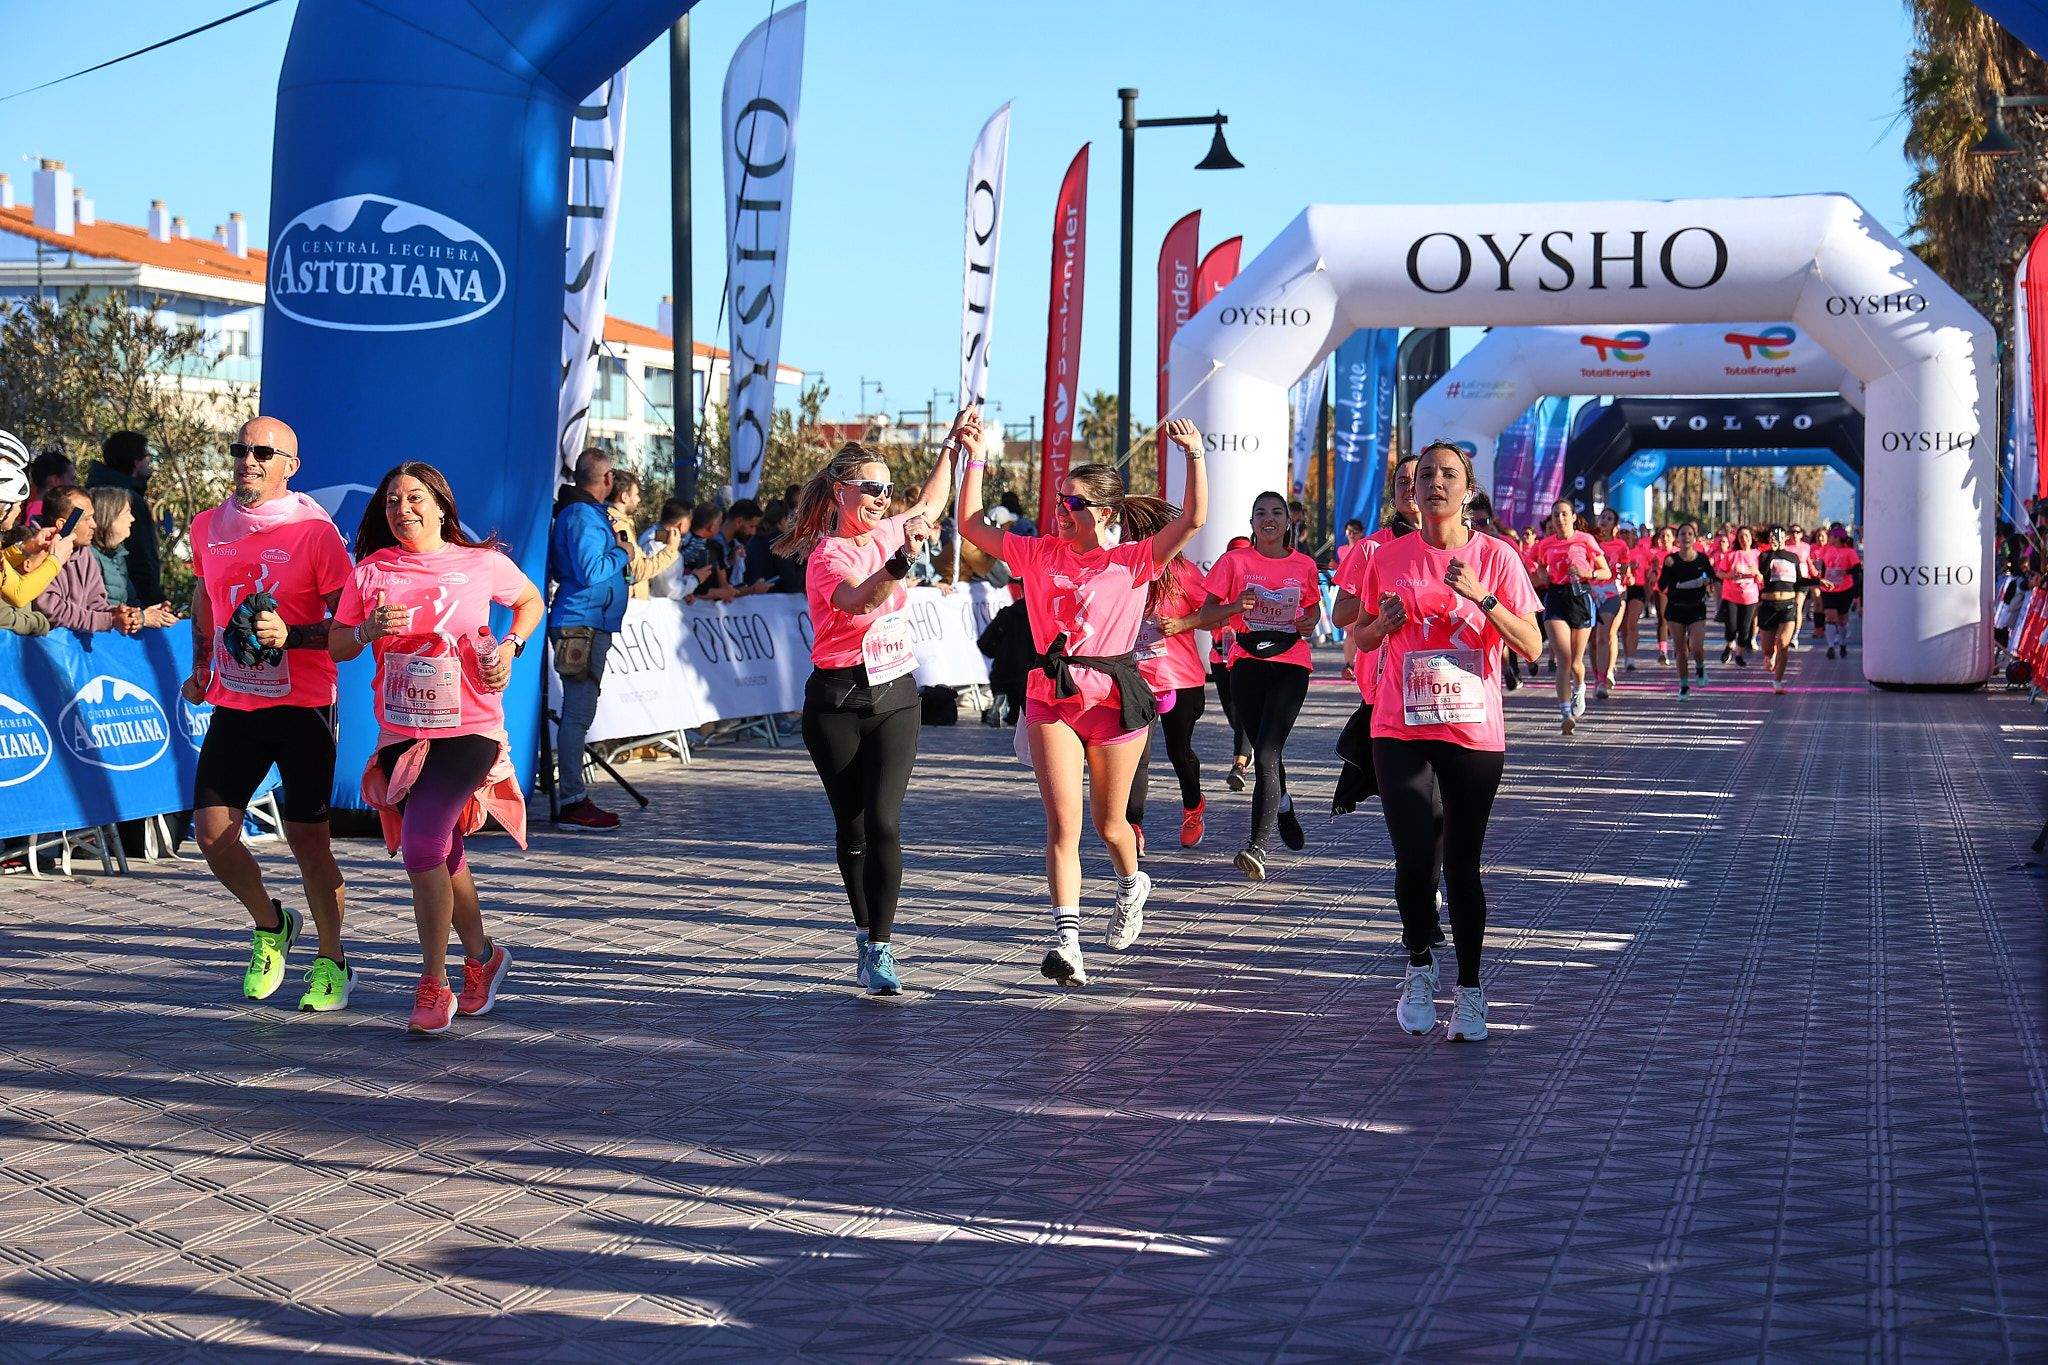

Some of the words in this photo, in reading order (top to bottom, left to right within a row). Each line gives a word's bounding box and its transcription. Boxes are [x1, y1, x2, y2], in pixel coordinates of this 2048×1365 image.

[302, 241, 379, 254] CENTRAL
[389, 243, 480, 262] LECHERA
[1406, 227, 1729, 294] OYSHO
[276, 244, 487, 303] ASTURIANA
[735, 97, 789, 484] OYSHO
[1826, 293, 1926, 316] OYSHO
[1220, 307, 1311, 327] OYSHO
[1580, 367, 1651, 379] TotalEnergies
[1724, 366, 1796, 377] TotalEnergies
[1652, 415, 1813, 431] VOLVO
[1882, 432, 1975, 452] OYSHO
[1881, 566, 1973, 586] OYSHO
[693, 613, 775, 664] OYSHO
[407, 687, 437, 701] 016
[1432, 682, 1462, 695] 016
[74, 715, 165, 751] ASTURIANA
